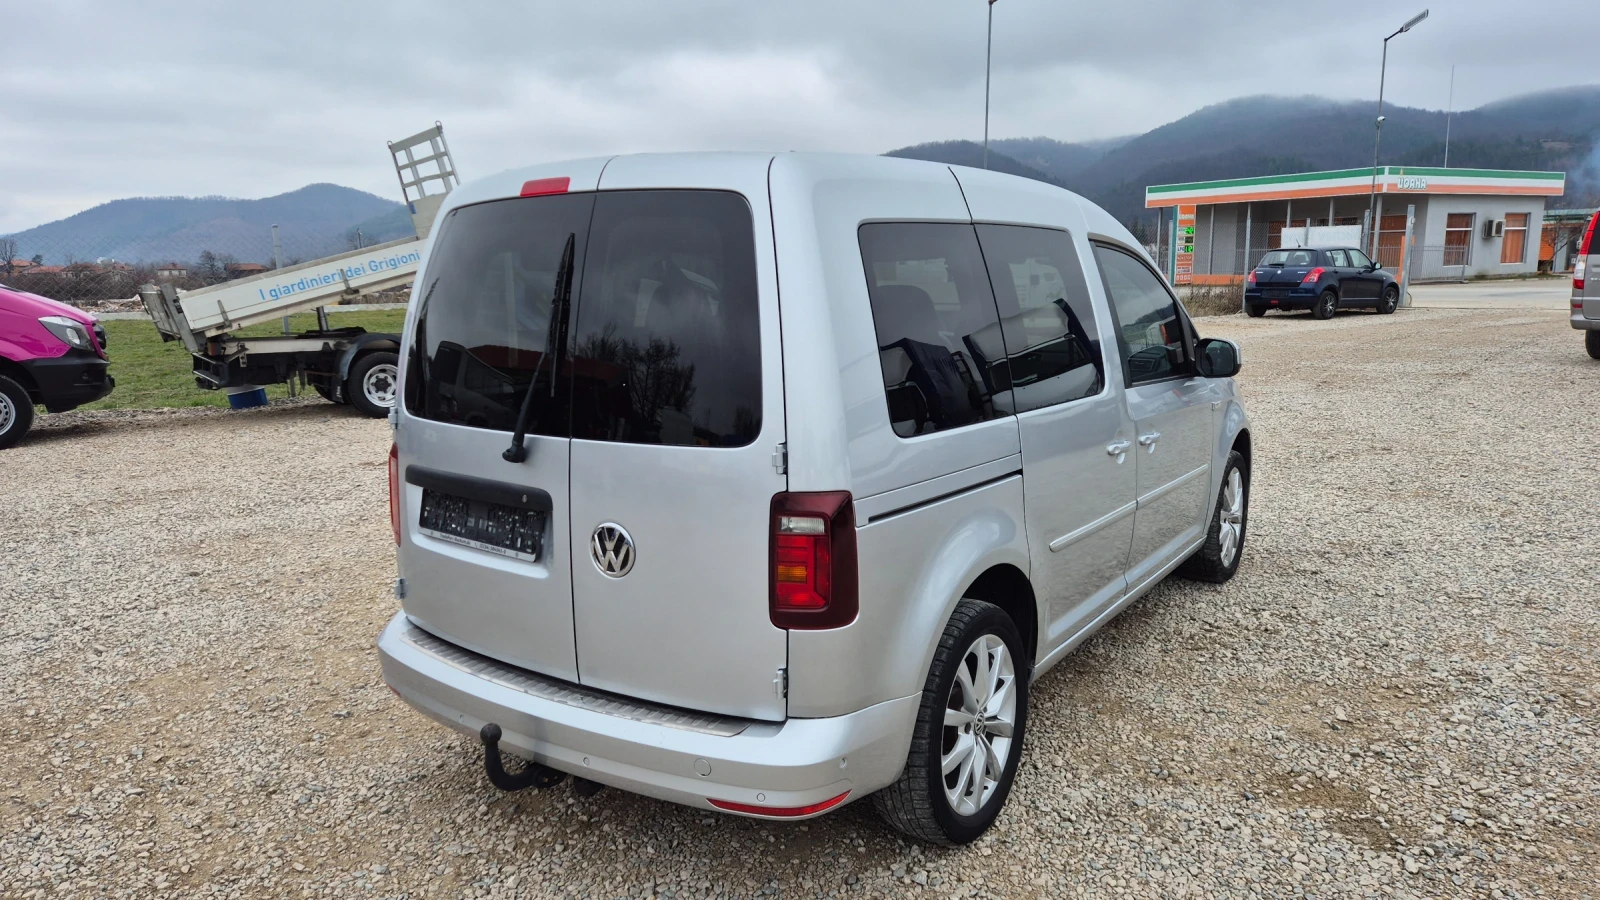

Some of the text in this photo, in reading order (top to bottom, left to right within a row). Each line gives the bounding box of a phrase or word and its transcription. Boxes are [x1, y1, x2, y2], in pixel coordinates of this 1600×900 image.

[259, 249, 421, 301] I giardinieri dei Grigioni
